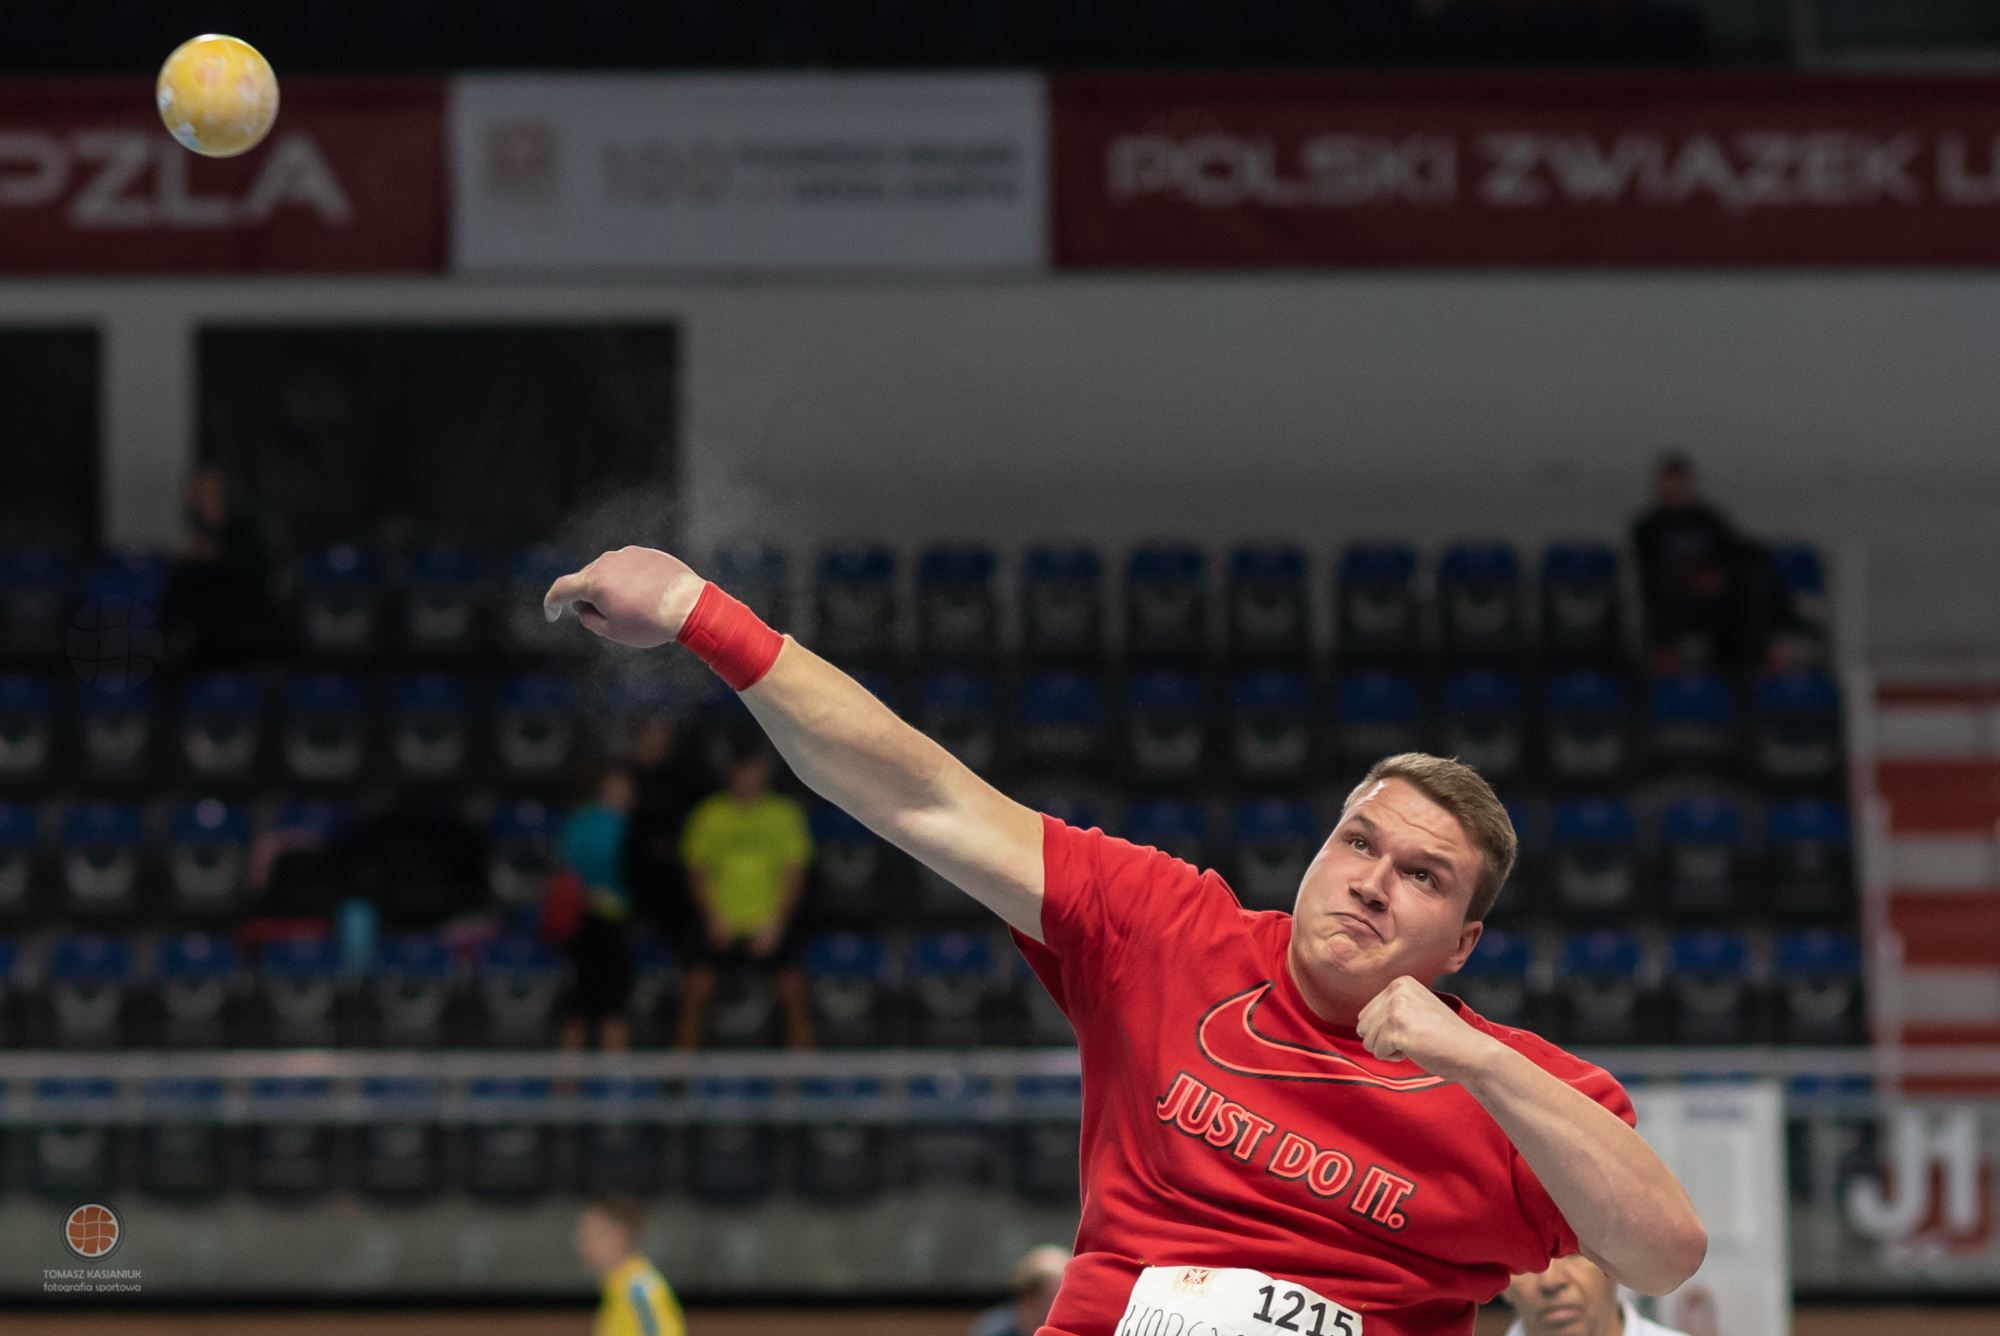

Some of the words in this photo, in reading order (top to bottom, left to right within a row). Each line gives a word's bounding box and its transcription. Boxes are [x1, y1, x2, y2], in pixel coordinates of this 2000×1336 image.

[0, 127, 353, 229] PZLA
[1104, 131, 1459, 207] POLSKI
[1478, 131, 1921, 216] ZWIĄZEK
[1155, 1071, 1275, 1162] JUST
[1266, 1130, 1355, 1199] DO
[1349, 1165, 1416, 1232] IT.
[1252, 1284, 1354, 1336] 1215
